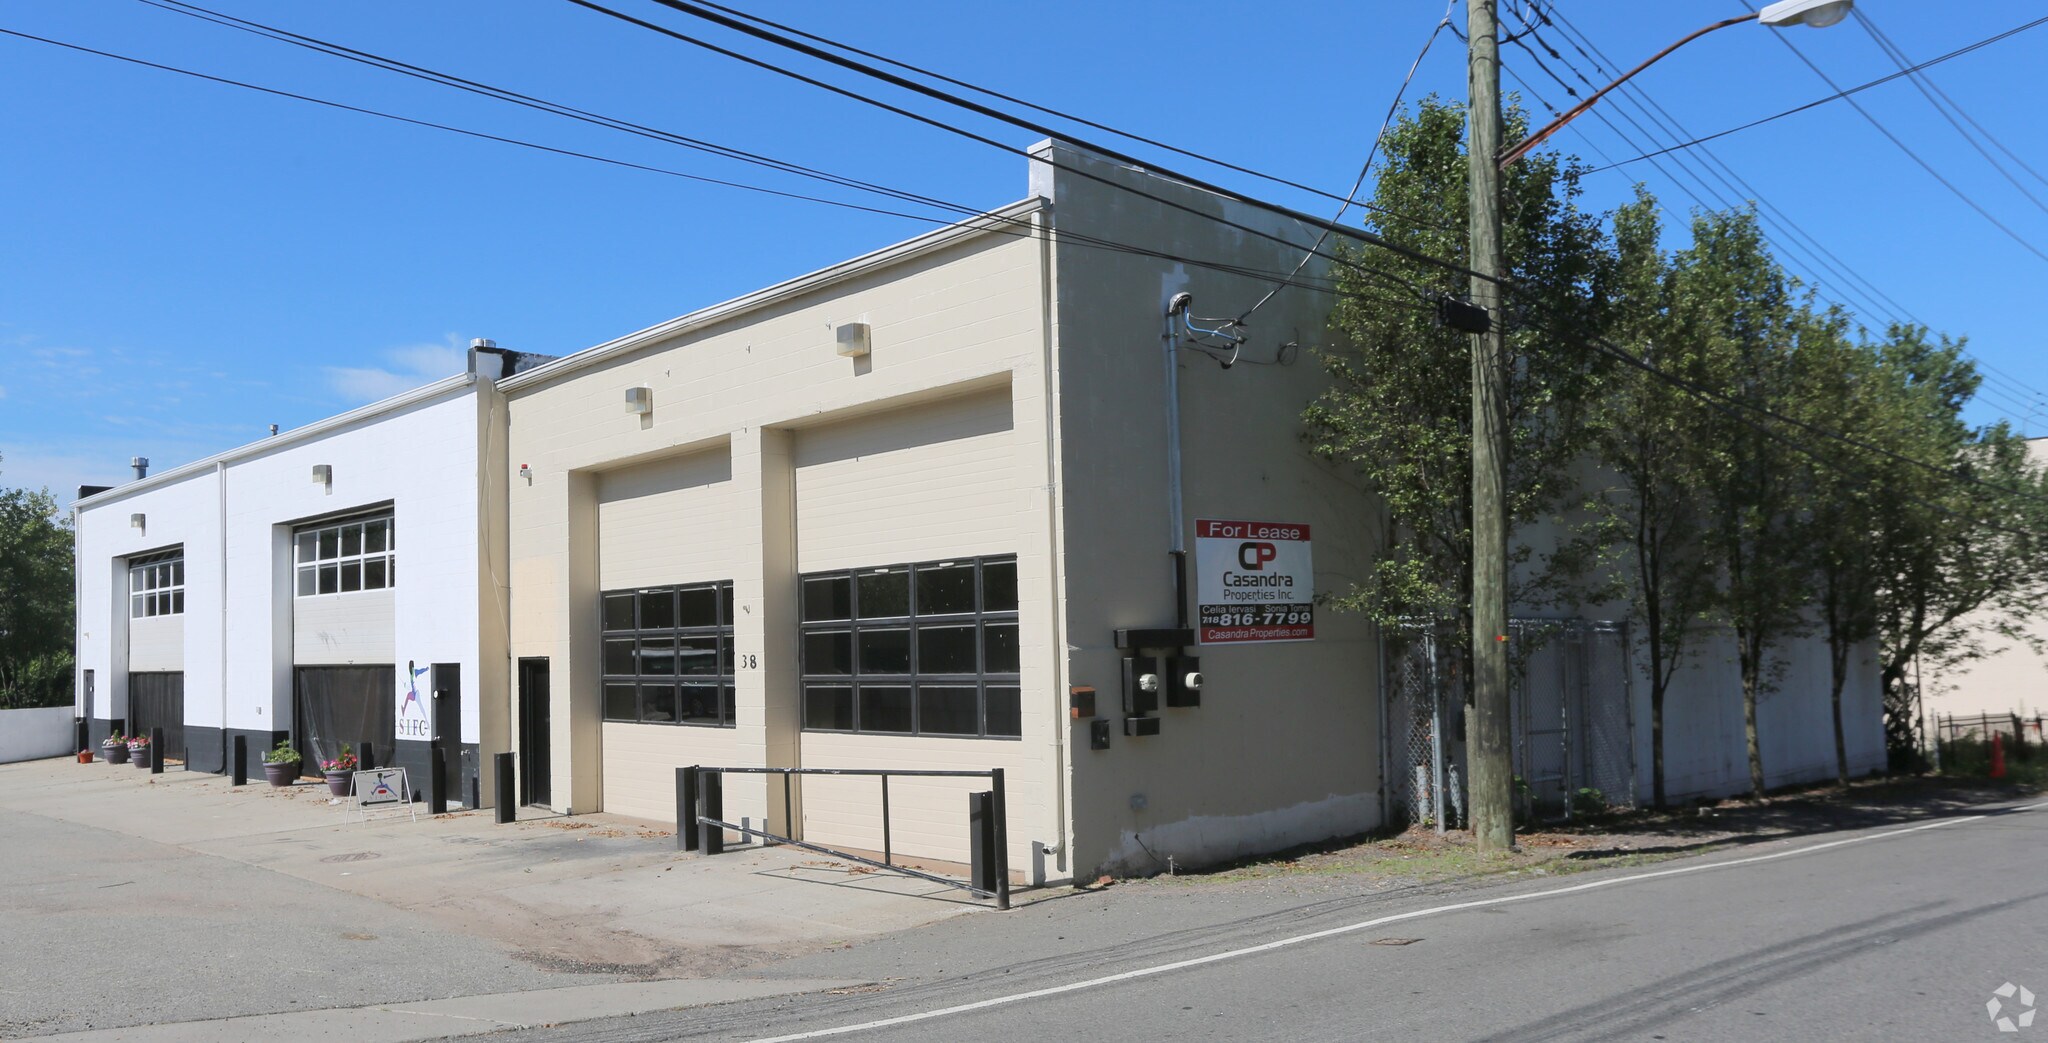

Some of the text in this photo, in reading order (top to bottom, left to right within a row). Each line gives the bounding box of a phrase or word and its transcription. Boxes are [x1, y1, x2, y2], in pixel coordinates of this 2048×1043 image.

[1209, 522, 1300, 539] For Lease
[1238, 542, 1277, 571] CP
[1223, 571, 1293, 587] Casandra
[1224, 589, 1294, 602] Properties Inc.
[1202, 605, 1226, 614] Celia
[1264, 604, 1287, 613] Sonia
[1202, 612, 1311, 626] 718 816-7799
[741, 654, 757, 669] 38
